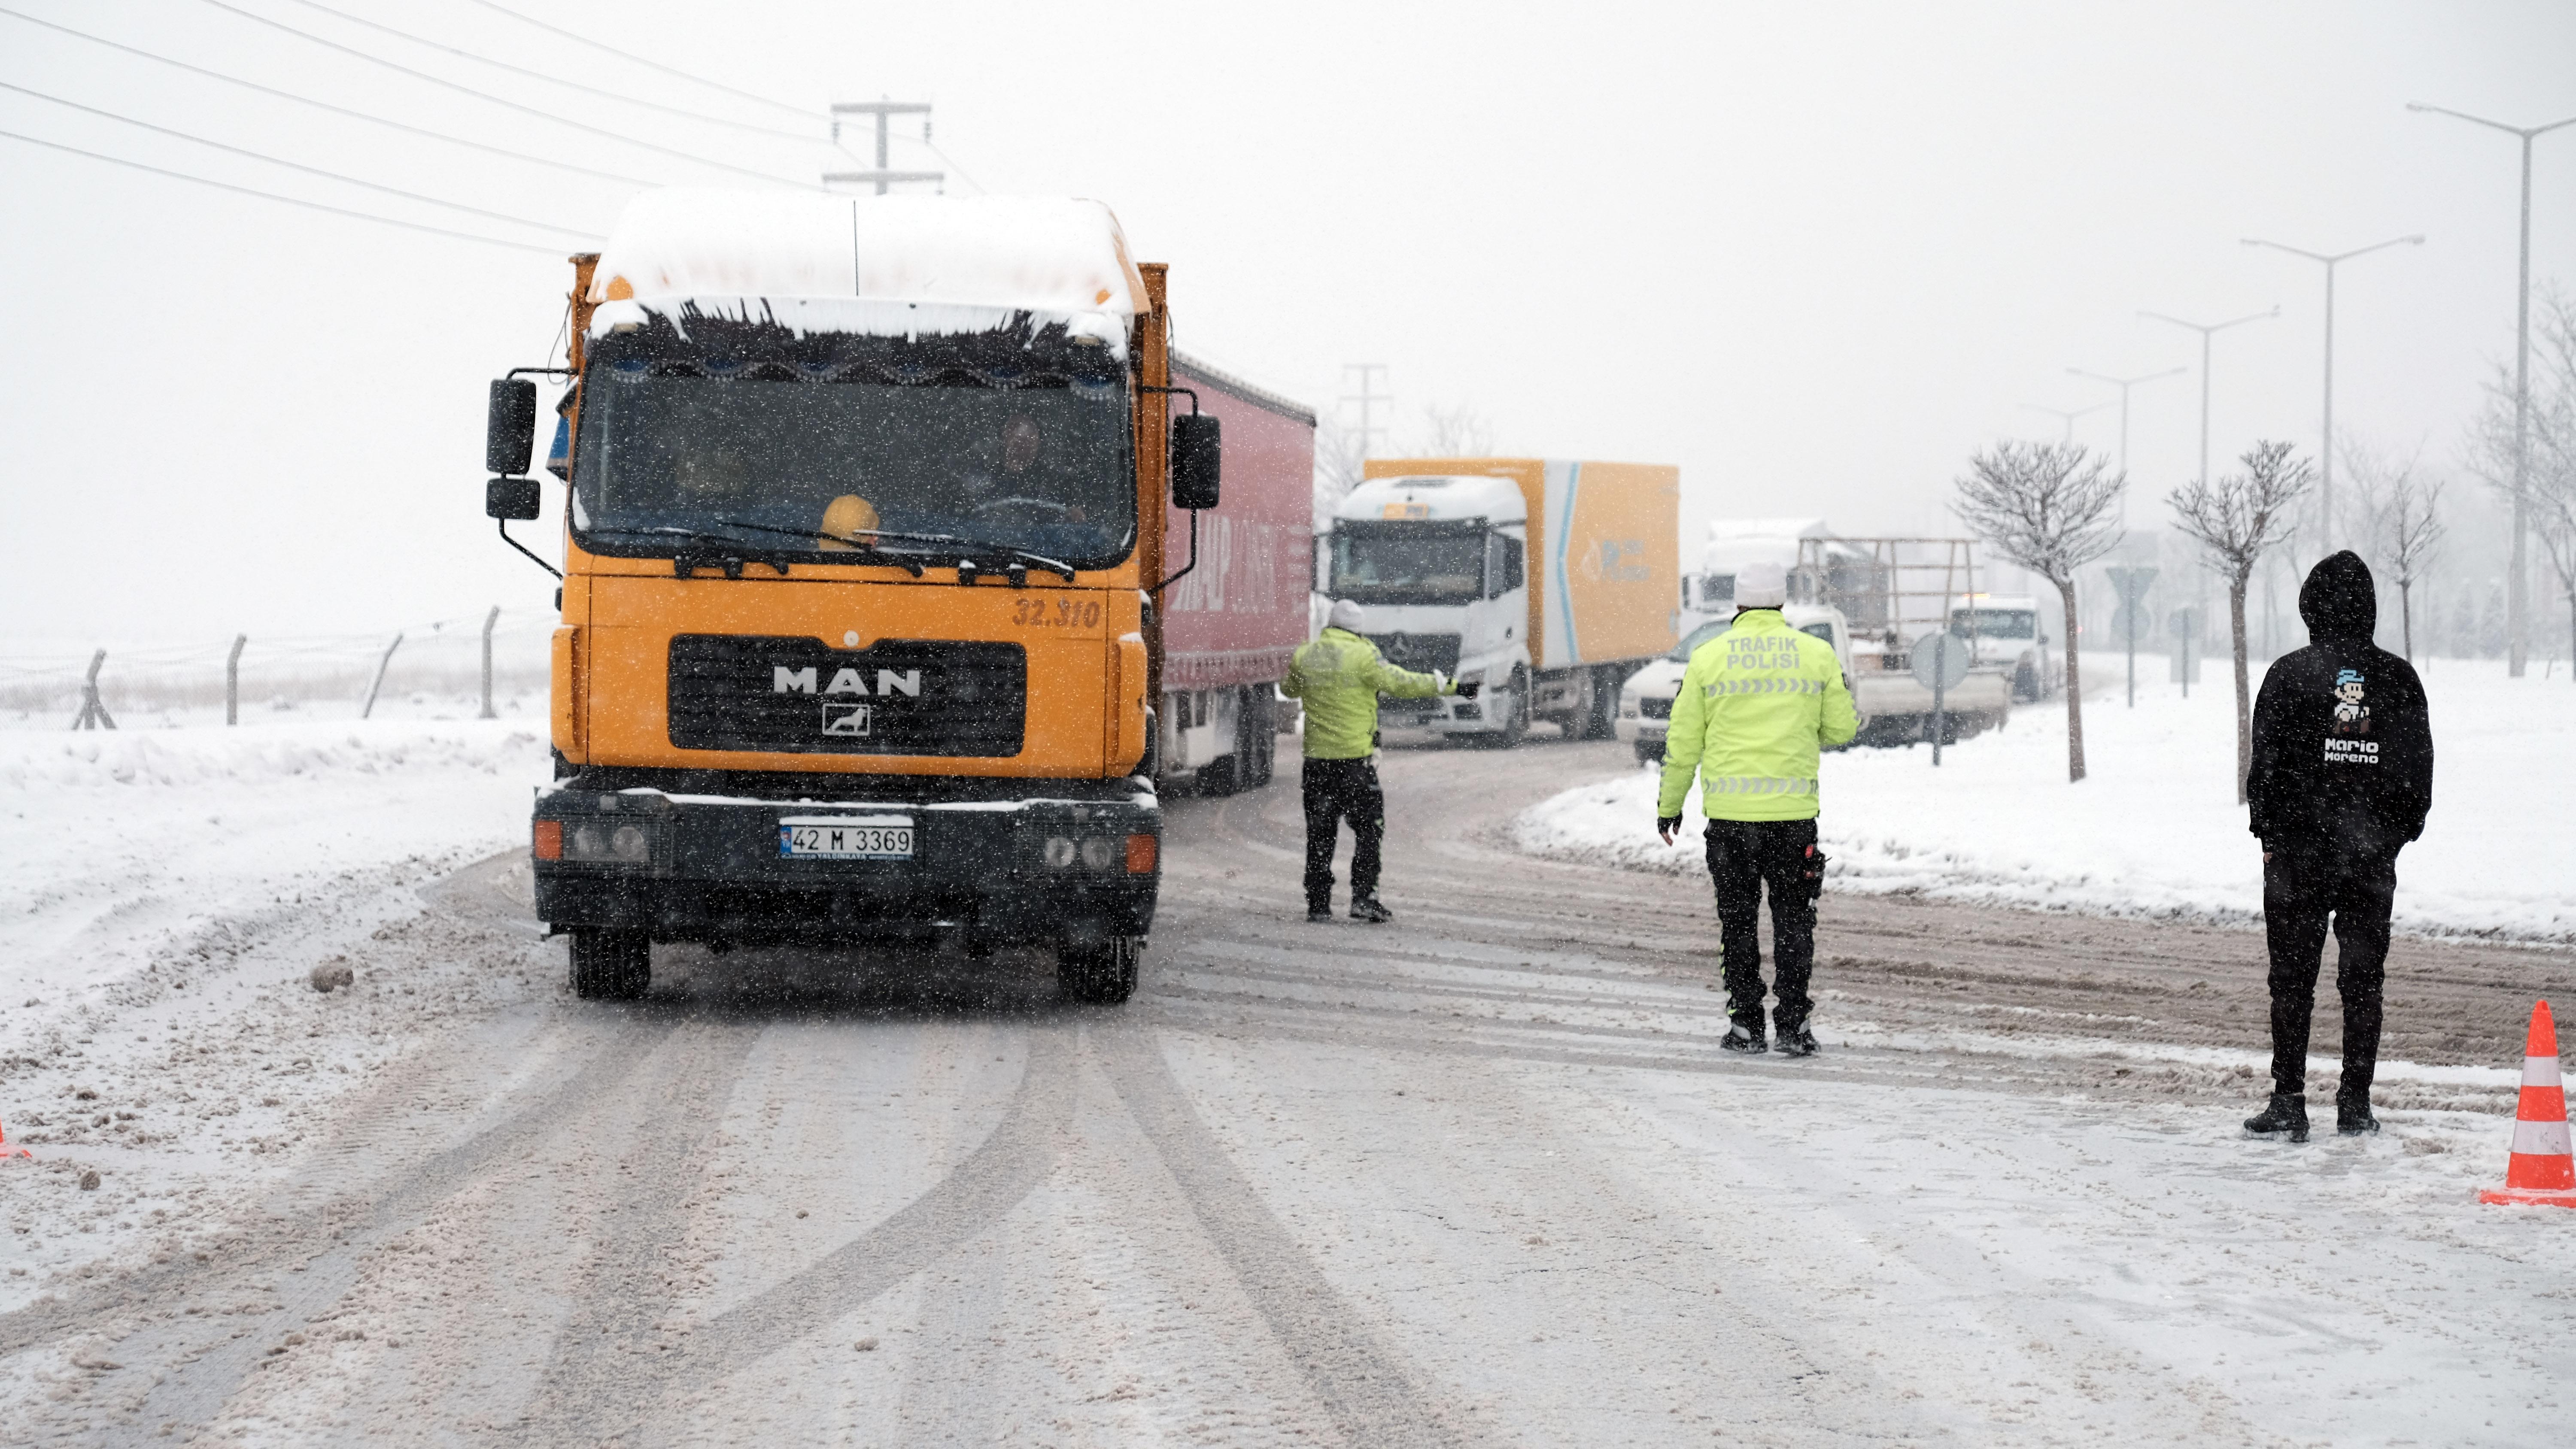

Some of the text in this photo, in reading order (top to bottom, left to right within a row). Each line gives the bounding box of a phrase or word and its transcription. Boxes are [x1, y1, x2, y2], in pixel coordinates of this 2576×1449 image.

[1012, 598, 1100, 628] 32.310
[774, 666, 920, 697] MAN
[2325, 738, 2379, 753] Mario
[2324, 751, 2379, 764] Moreno
[793, 829, 909, 852] 42 M 3369
